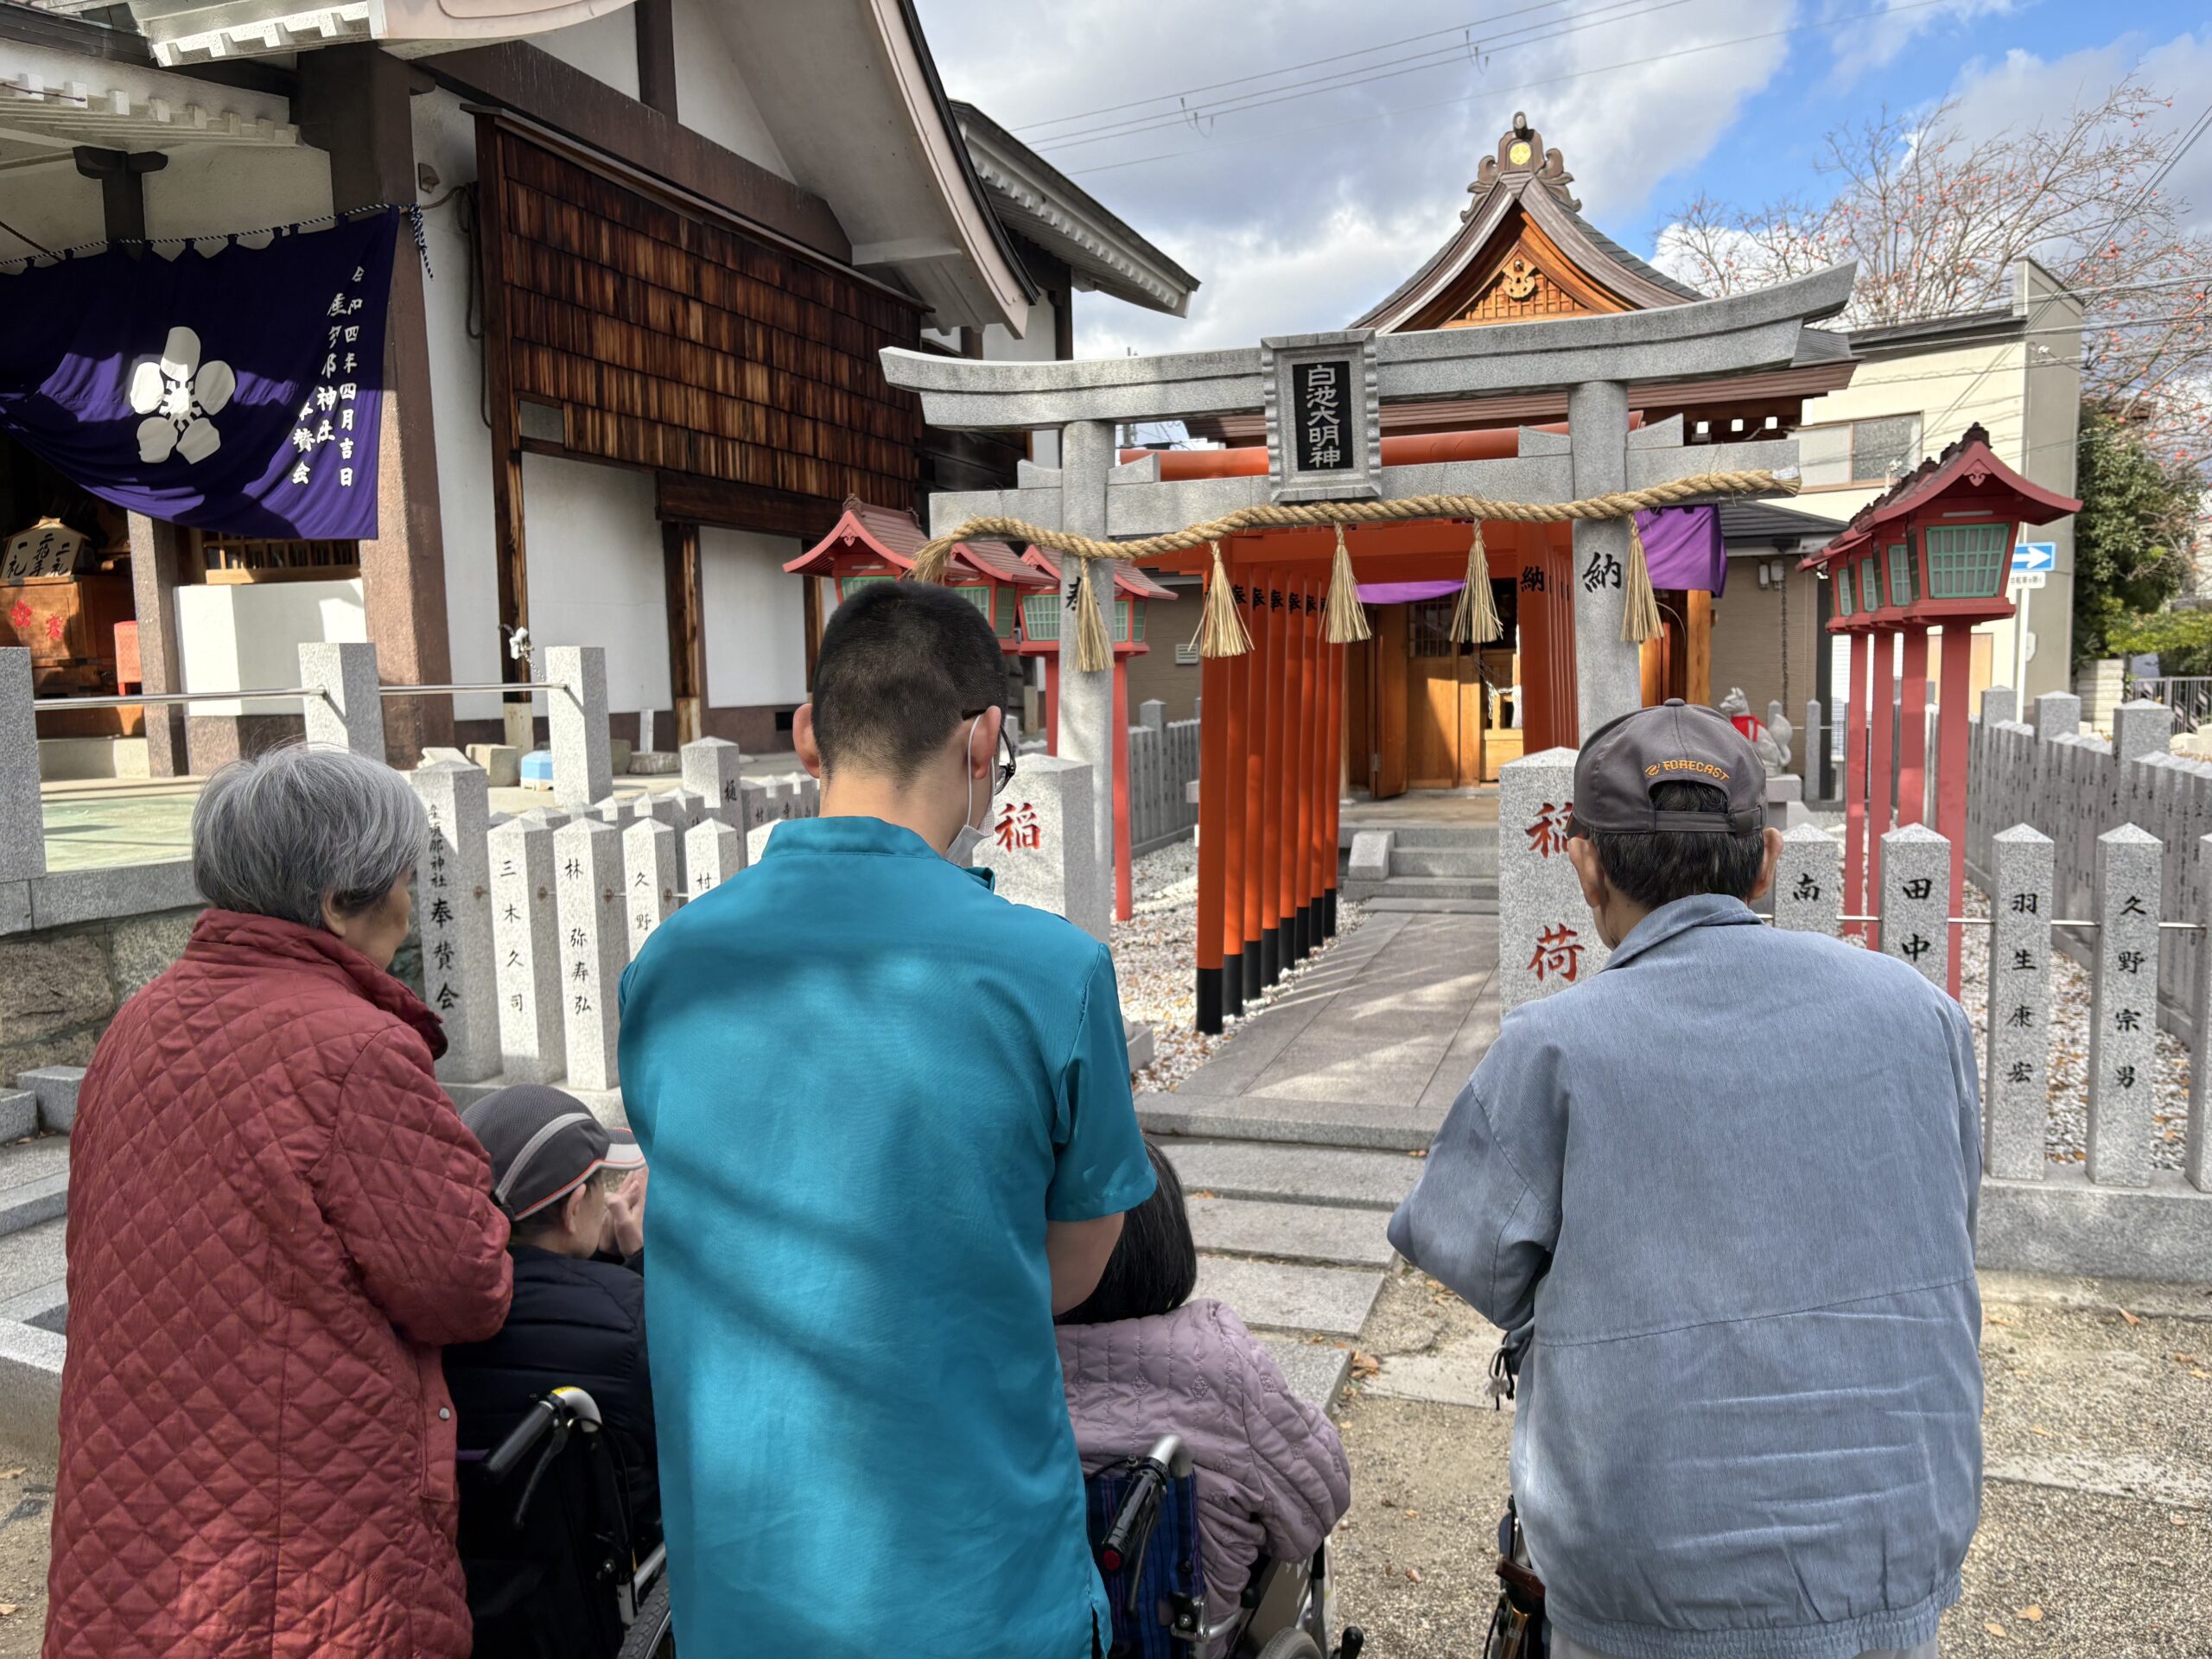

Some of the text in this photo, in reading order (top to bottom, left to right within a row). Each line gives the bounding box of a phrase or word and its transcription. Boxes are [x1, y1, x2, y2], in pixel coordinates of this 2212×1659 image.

[1306, 365, 1341, 468] 白池大明神
[1520, 566, 1545, 593] 納
[1582, 551, 1622, 593] 納
[1662, 760, 1730, 781] FORECAST
[995, 802, 1041, 853] 稲
[634, 871, 652, 931] 久野
[1792, 873, 1821, 902] 南
[500, 860, 524, 1012] 三木久司
[1902, 878, 1933, 963] 田中
